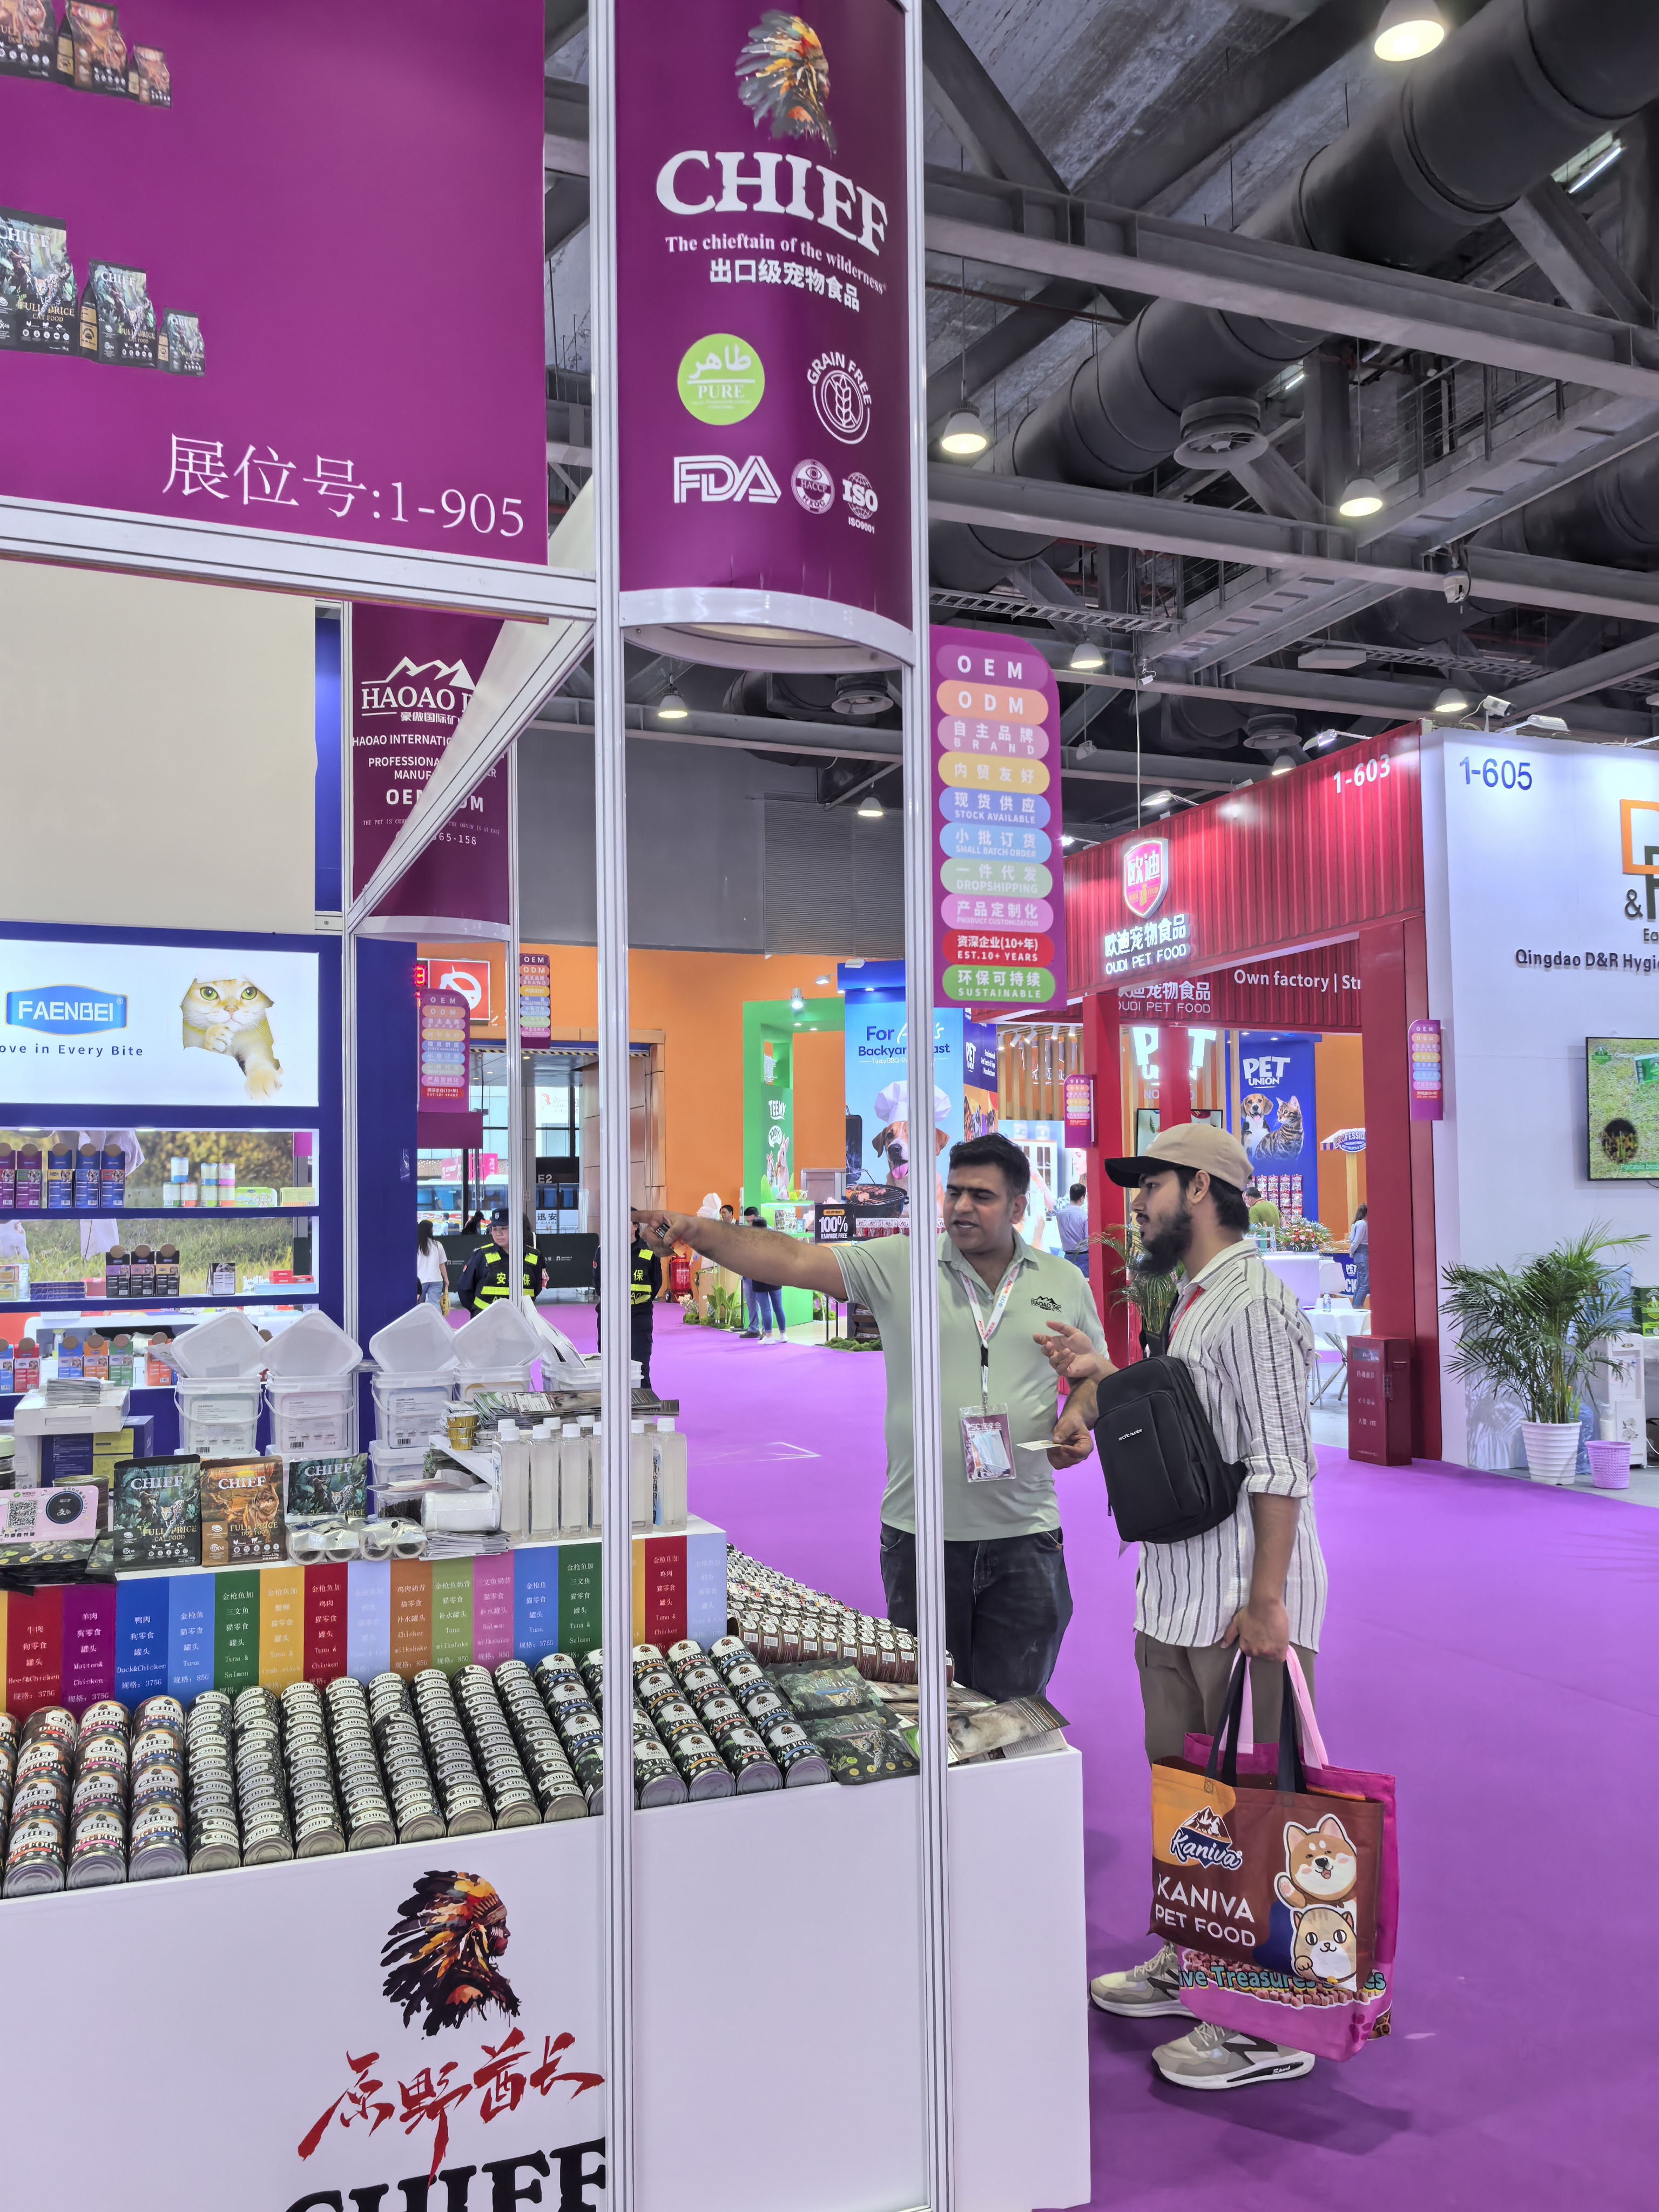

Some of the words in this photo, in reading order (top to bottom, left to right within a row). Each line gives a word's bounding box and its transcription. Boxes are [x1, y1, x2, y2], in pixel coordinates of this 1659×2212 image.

[656, 150, 888, 256] CHIEF
[665, 237, 698, 253] The
[703, 233, 775, 251] chieftain
[780, 238, 798, 252] of
[801, 242, 822, 261] the
[100, 271, 136, 287] CHIEF
[710, 258, 860, 312] 出口级宠物食品
[46, 314, 64, 322] FOOD
[689, 344, 752, 379] طاهر
[807, 352, 846, 385] GRAIN
[848, 360, 872, 406] FREE
[698, 385, 745, 400] PURE
[674, 455, 781, 504] FDA
[800, 479, 828, 493] HACCP
[842, 478, 879, 512] ISO
[848, 516, 875, 534] ISO9001
[957, 655, 1022, 679] OEM
[361, 686, 455, 711] HAOAO
[959, 691, 1023, 714] ODM
[401, 712, 462, 725] 豪傲国际矿
[954, 720, 1034, 744] 自主品牌
[353, 735, 387, 747] HAOAO
[954, 738, 1034, 755] BRAND
[368, 757, 440, 767] PROFESSIONA
[954, 763, 1034, 784] 内贸友好
[1333, 753, 1391, 794] 1-603
[1460, 756, 1533, 791] 1-605
[954, 792, 1035, 813] 现货供应
[955, 810, 984, 820] STOCK
[987, 812, 1035, 824] AVAILABLE
[955, 828, 1035, 848] 小批订货
[956, 845, 981, 854] SMALL
[983, 846, 1008, 857] BATCH
[1010, 848, 1036, 858] ORDER
[956, 864, 1036, 881] 一件代发
[1127, 851, 1161, 887] 欧迪
[956, 879, 1037, 893] DROPSHIPPING
[957, 901, 1037, 919] 产品定制化
[957, 916, 987, 925] PRODUCT
[988, 918, 1038, 927] CUSTOMIZATION
[1104, 913, 1186, 957] 欧迪宠物食品
[957, 935, 1038, 951] 资深企业(10+年)
[957, 951, 1000, 960] EST.10+
[1004, 953, 1038, 962] YEARS
[1105, 958, 1128, 975] OUDI
[1131, 953, 1153, 968] PET
[1157, 943, 1187, 963] FOOD
[1515, 949, 1582, 970] Qingdao
[1585, 952, 1619, 968] D&R
[957, 970, 1041, 988] 环保可持续
[1234, 969, 1269, 986] Own
[1273, 970, 1328, 993] factory
[959, 988, 1041, 999] SUSTAINABLE
[18, 1001, 113, 1022] FAENBEI
[1147, 1002, 1171, 1013] PET
[1177, 1002, 1211, 1014] FOOD
[867, 1026, 894, 1041] For
[0, 1043, 26, 1054] ove
[35, 1043, 50, 1054] in
[58, 1044, 104, 1057] Every
[111, 1045, 144, 1057] Bite
[859, 1045, 907, 1058] Backyar
[966, 1042, 976, 1063] PET
[1132, 1027, 1217, 1067] PT
[1243, 1056, 1291, 1080] PET
[1248, 1076, 1280, 1085] UNION
[1333, 1132, 1365, 1148] PROFESSIO
[538, 1174, 552, 1183] E2
[819, 1216, 848, 1233] 100%
[634, 1270, 643, 1282] 保
[1346, 1264, 1357, 1273] PET
[1030, 1299, 1051, 1309] HAOAO
[304, 1462, 353, 1478] CHIEF
[130, 1475, 184, 1490] CHIEF
[218, 1476, 266, 1489] CHIEF
[397, 1584, 426, 1593] 鸡肉奶昔
[436, 1580, 471, 1590] 金枪鱼奶昔
[476, 1577, 511, 1586] 三文鱼奶昔
[222, 1591, 253, 1600] 金枪鱼加
[181, 1611, 204, 1620] 金枪鱼
[227, 1607, 249, 1615] 三文鱼
[397, 1614, 426, 1623] 补水罐头
[134, 1616, 151, 1624] 鸭肉
[23, 1642, 47, 1650] 狗零食
[394, 1645, 428, 1654] milkshake
[26, 1658, 43, 1666] 罐头
[117, 1663, 166, 1674] Duck&Chicken
[8, 1675, 59, 1684] Beef&Chicken
[139, 1776, 176, 1788] CHIEF
[16, 1790, 53, 1805] CHIEF
[77, 1783, 116, 1797] CHIEF
[81, 1823, 120, 1833] CHIEF
[137, 1815, 175, 1830] CHIEF
[14, 1831, 53, 1844] CHIEF
[1172, 1832, 1240, 1867] Kaniva
[1157, 1874, 1255, 1923] KANIVA
[1155, 1904, 1188, 1928] PET
[1195, 1917, 1256, 1947] FOOD
[298, 2027, 605, 2189] 原野酋长
